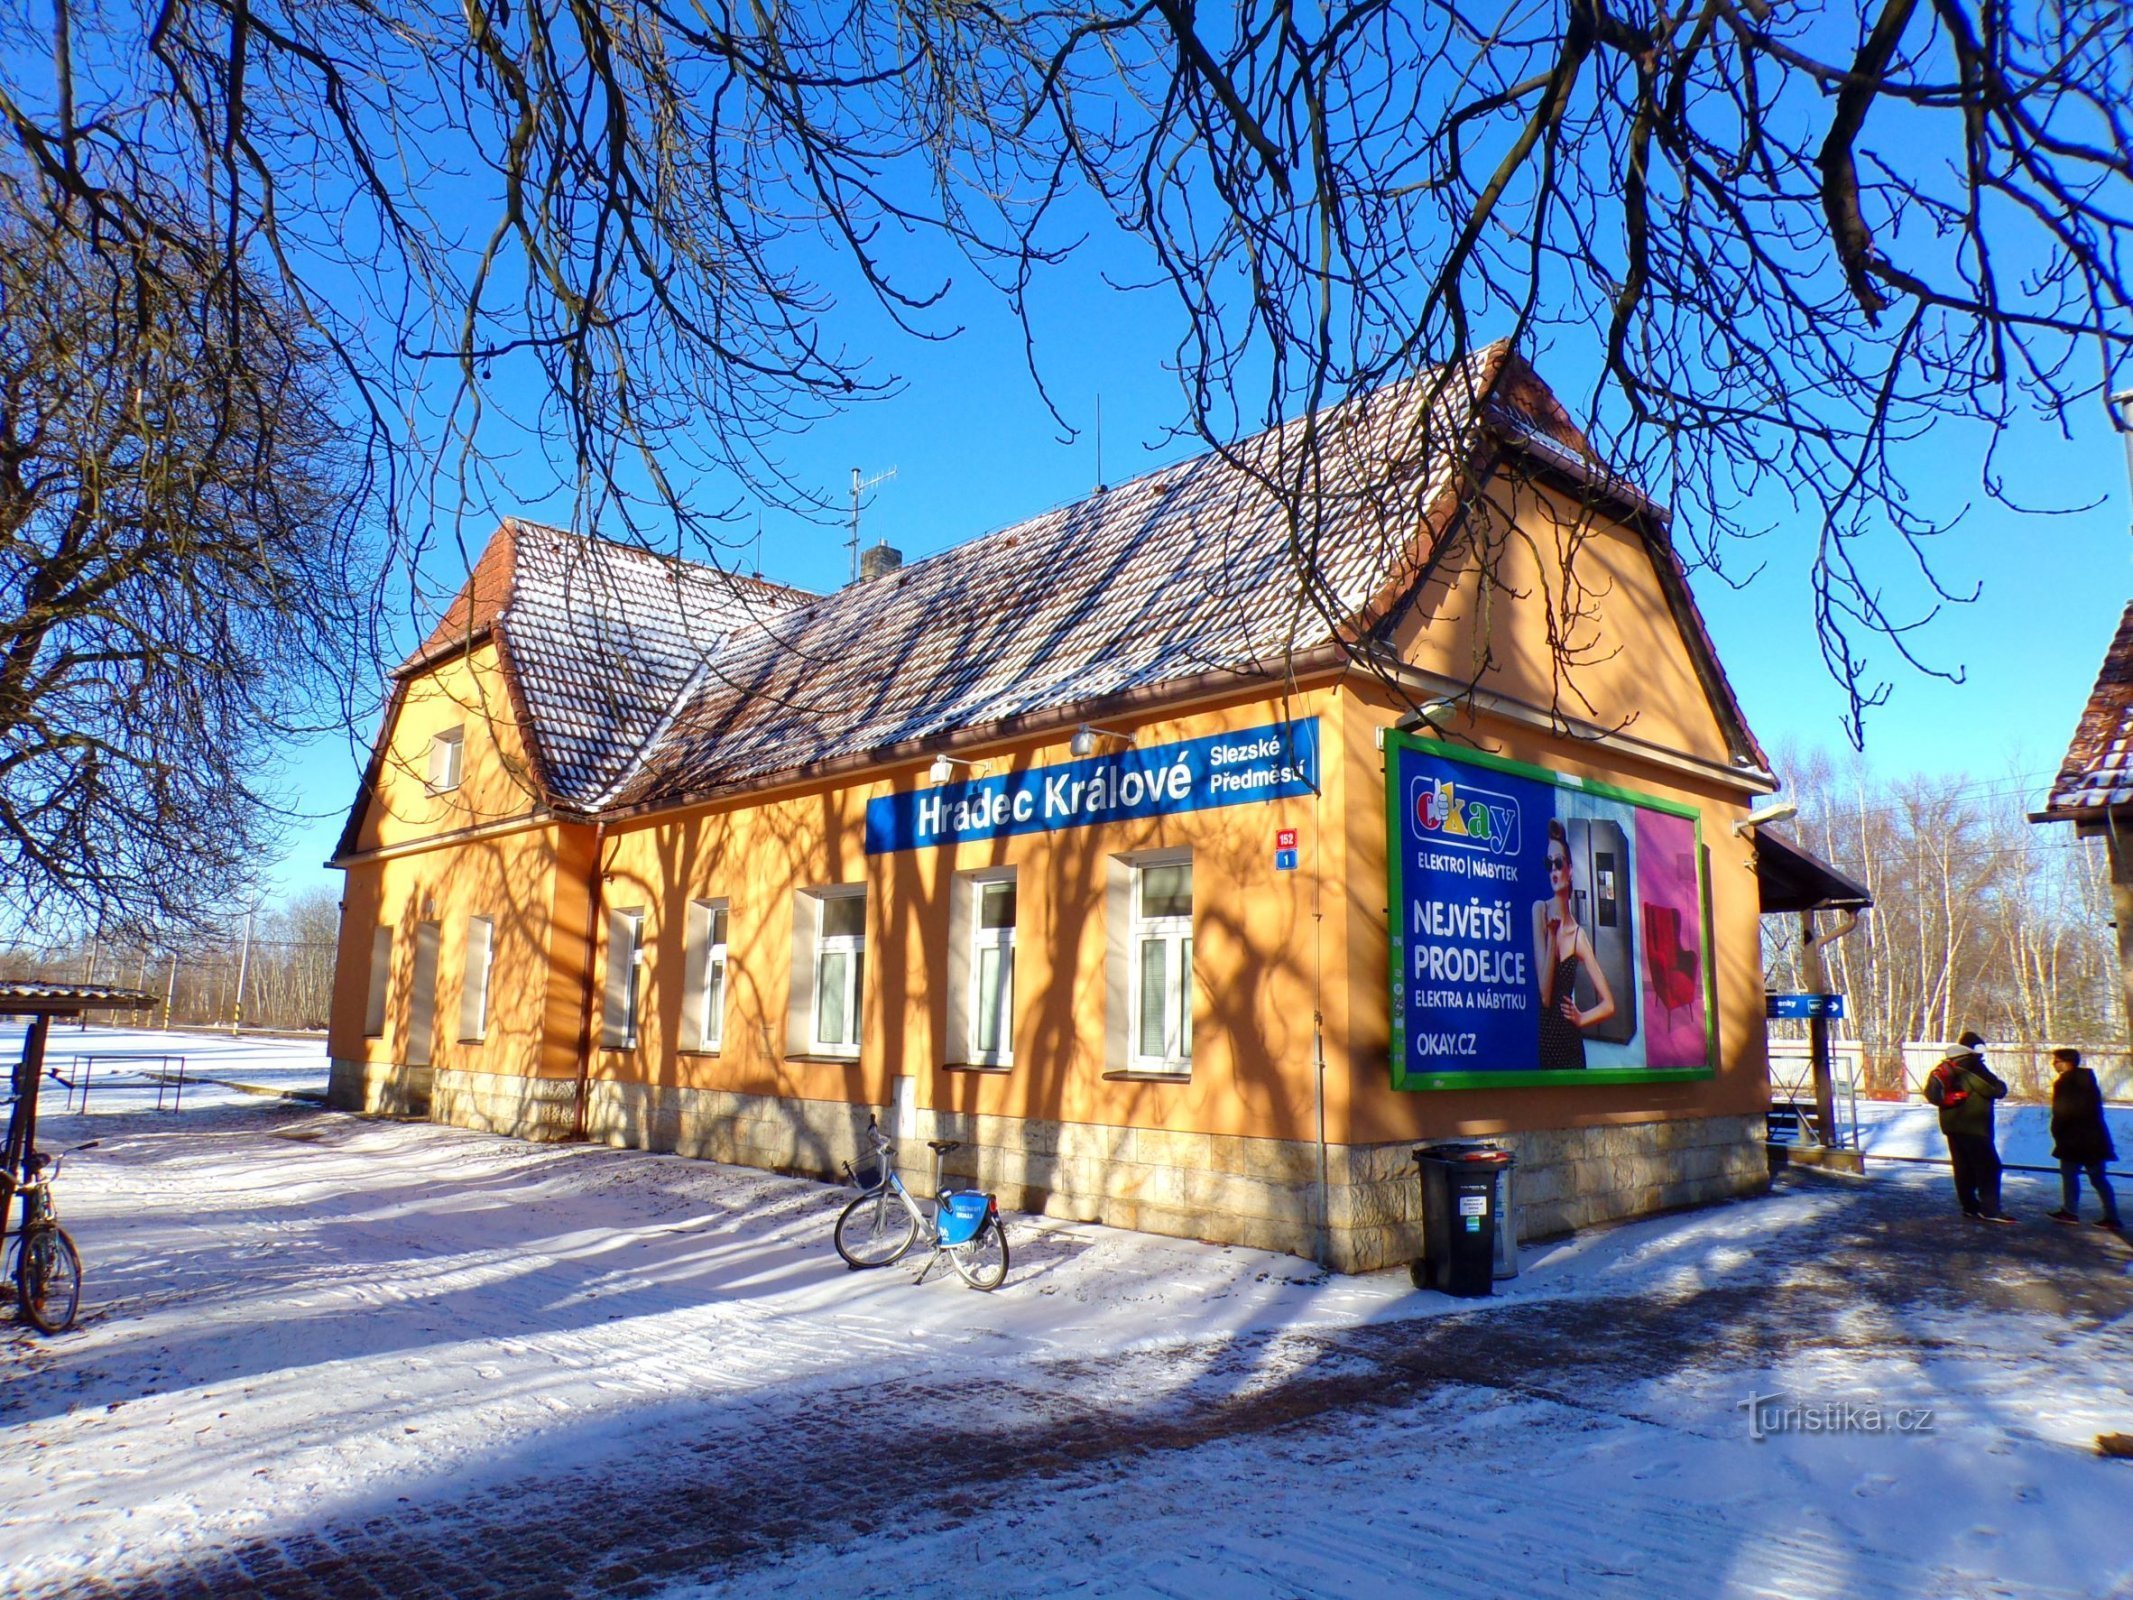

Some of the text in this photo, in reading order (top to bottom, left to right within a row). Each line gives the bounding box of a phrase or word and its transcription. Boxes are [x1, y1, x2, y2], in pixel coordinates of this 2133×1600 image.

[1210, 735, 1280, 766] Slezské
[918, 750, 1192, 836] Hradec Králové
[1279, 833, 1294, 846] 152
[1283, 854, 1289, 866] 1
[1418, 851, 1518, 881] ELEKTRO NÁBYTEK
[1413, 896, 1512, 942] NEJVĚTŠÍ
[1414, 944, 1526, 985] PRODEJCE
[1415, 987, 1526, 1010] ELEKTRA A NÁBYTKU
[1416, 1033, 1477, 1056] OKAY.CZ
